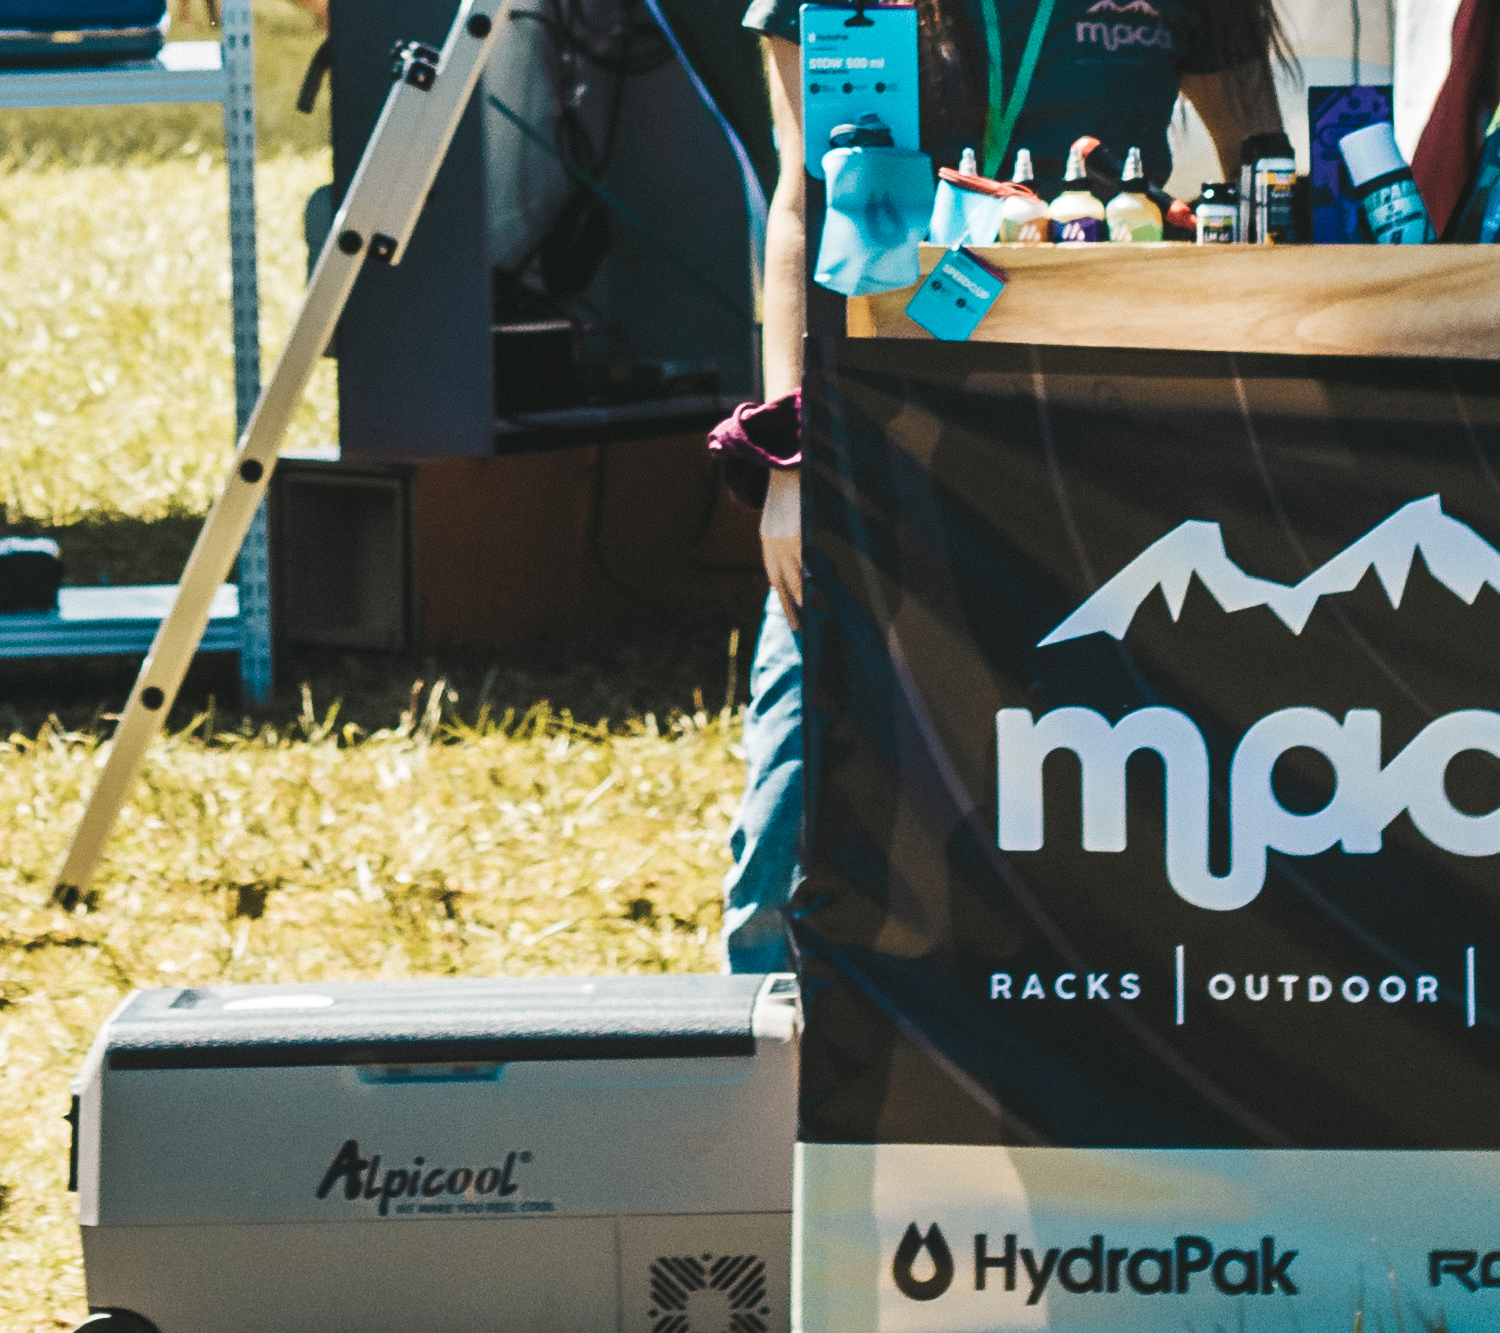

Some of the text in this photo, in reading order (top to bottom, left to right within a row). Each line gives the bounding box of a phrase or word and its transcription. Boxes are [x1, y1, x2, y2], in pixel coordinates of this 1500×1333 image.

[989, 971, 1143, 1002] RACKS
[1206, 971, 1442, 1004] OUTDOOR
[315, 1139, 520, 1217] Alpicool
[973, 1234, 1300, 1305] HydraPak
